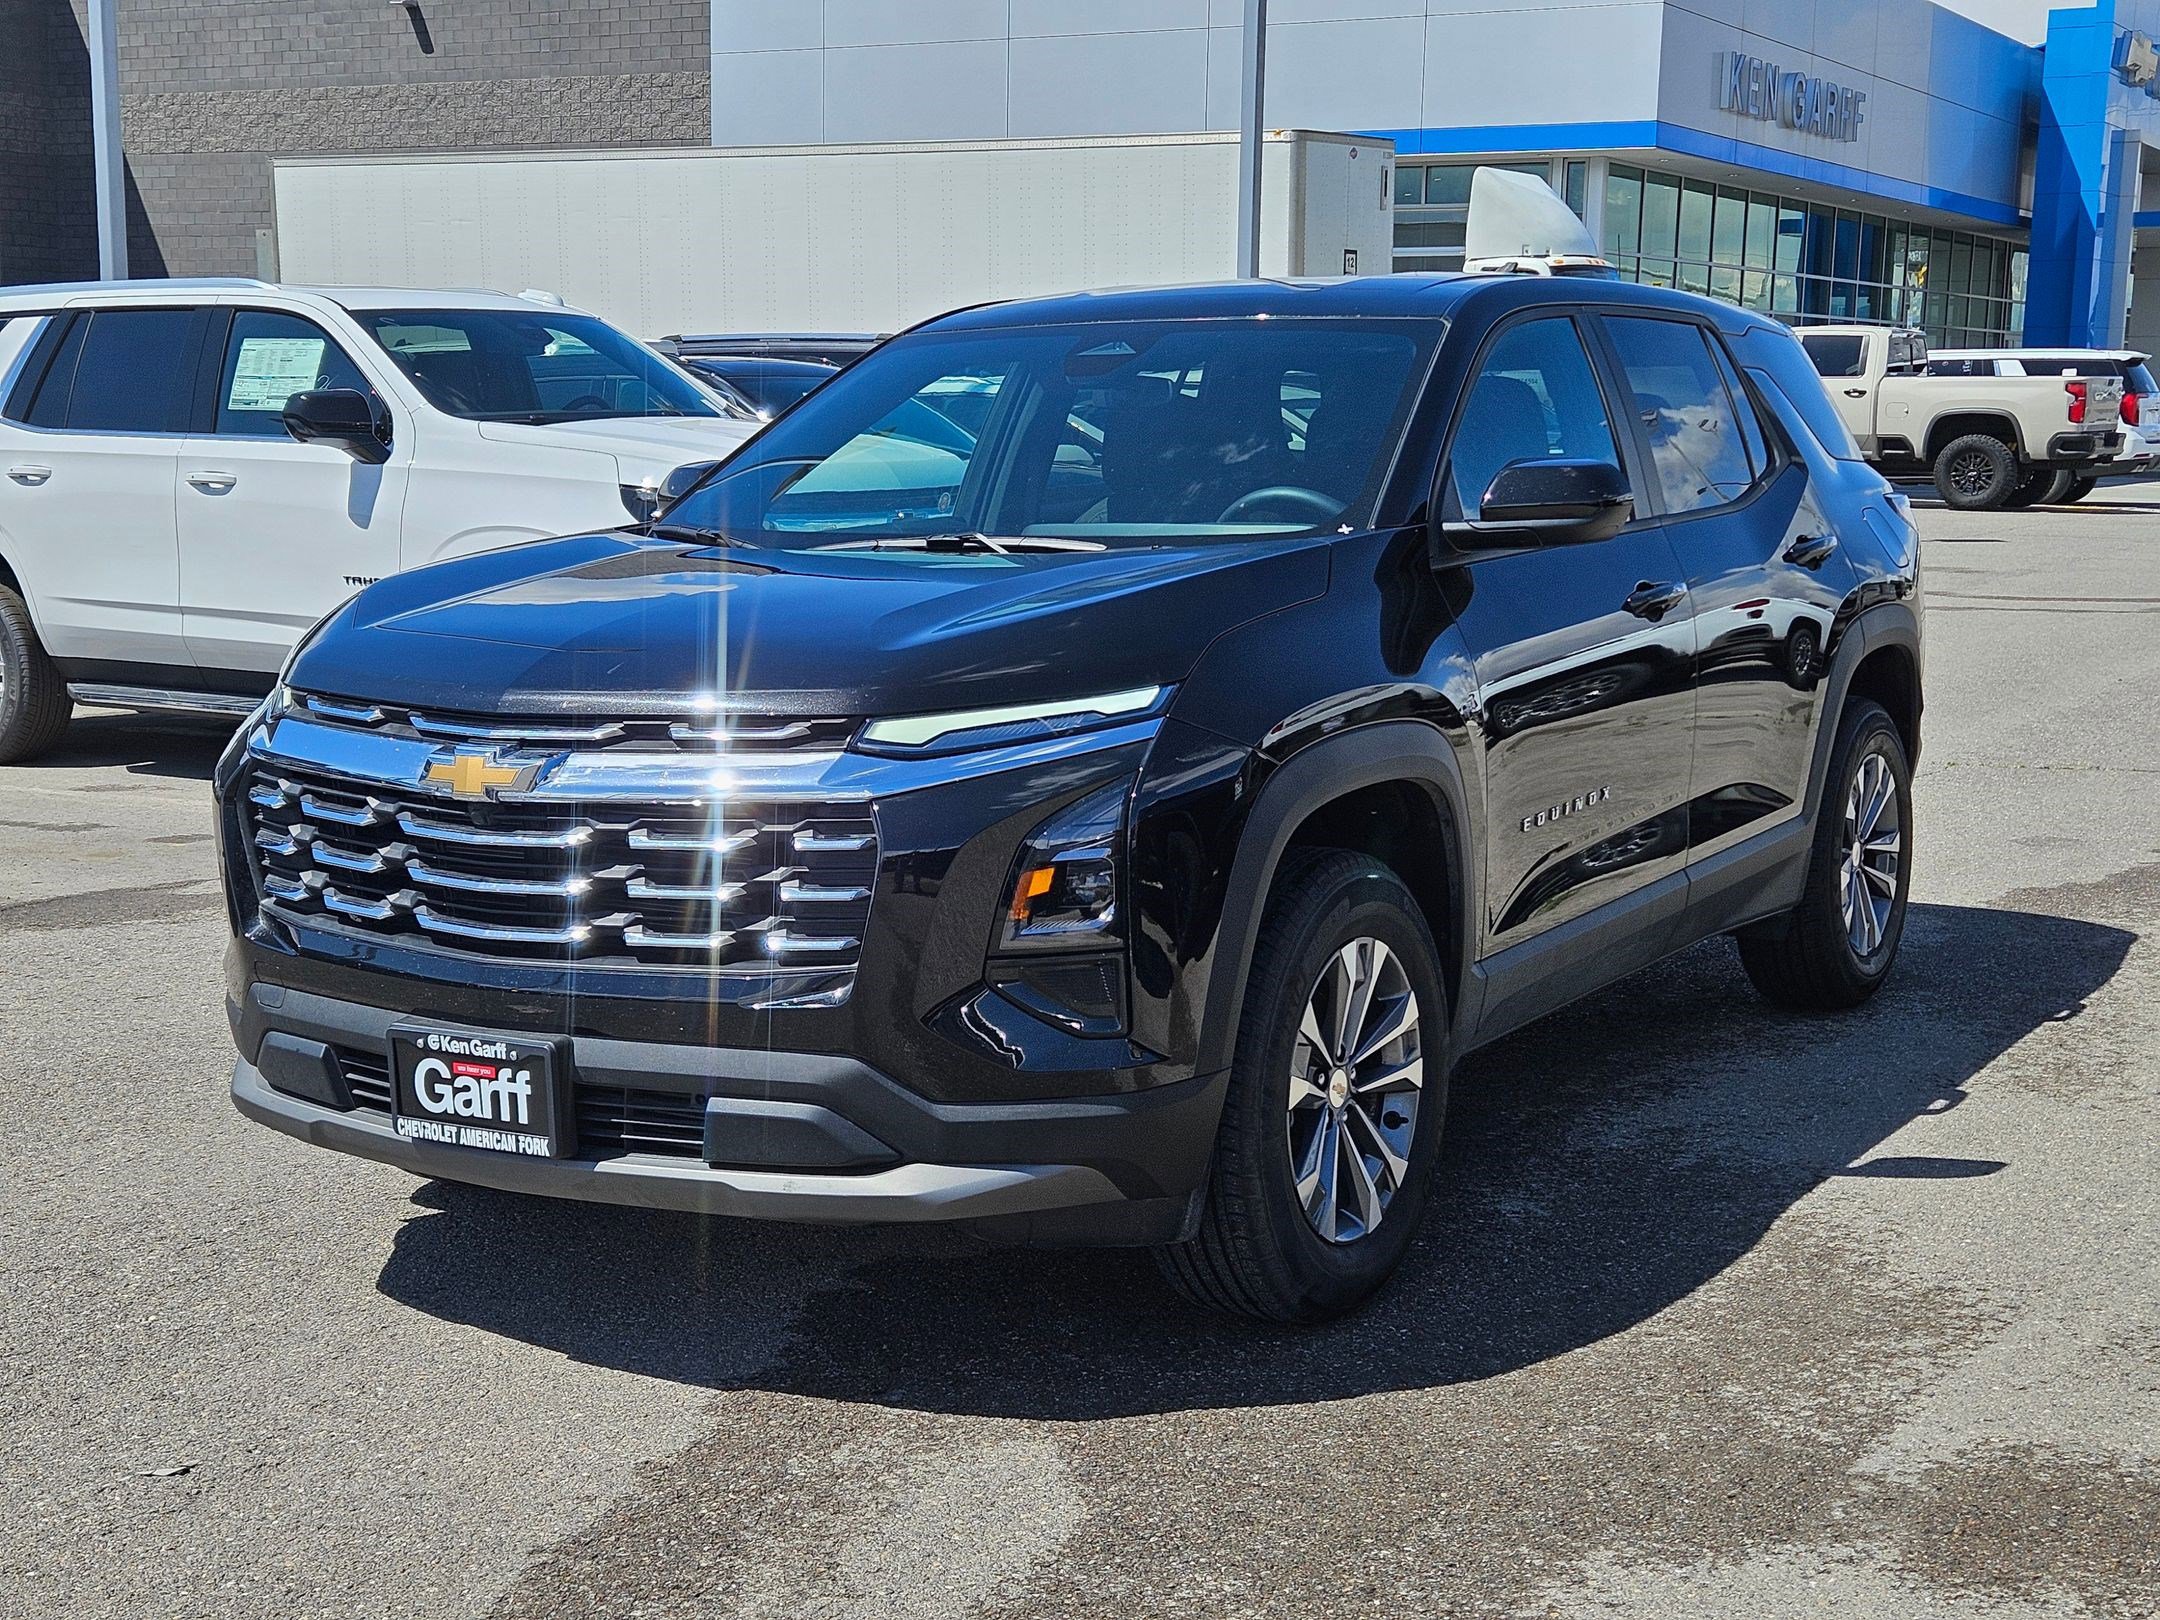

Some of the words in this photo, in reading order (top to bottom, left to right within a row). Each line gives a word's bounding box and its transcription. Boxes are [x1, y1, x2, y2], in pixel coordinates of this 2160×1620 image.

[1723, 51, 1780, 121] KEN
[1786, 72, 1866, 142] GARFF
[1347, 257, 1355, 268] 12
[1521, 784, 1610, 832] EQUINOX
[440, 1035, 470, 1055] Ken
[470, 1039, 507, 1060] Garff
[414, 1057, 532, 1125] Garff
[480, 1068, 491, 1076] you
[397, 1118, 458, 1143] CHEVROLET
[459, 1128, 517, 1153] AMERICAN
[518, 1136, 550, 1157] FORK
